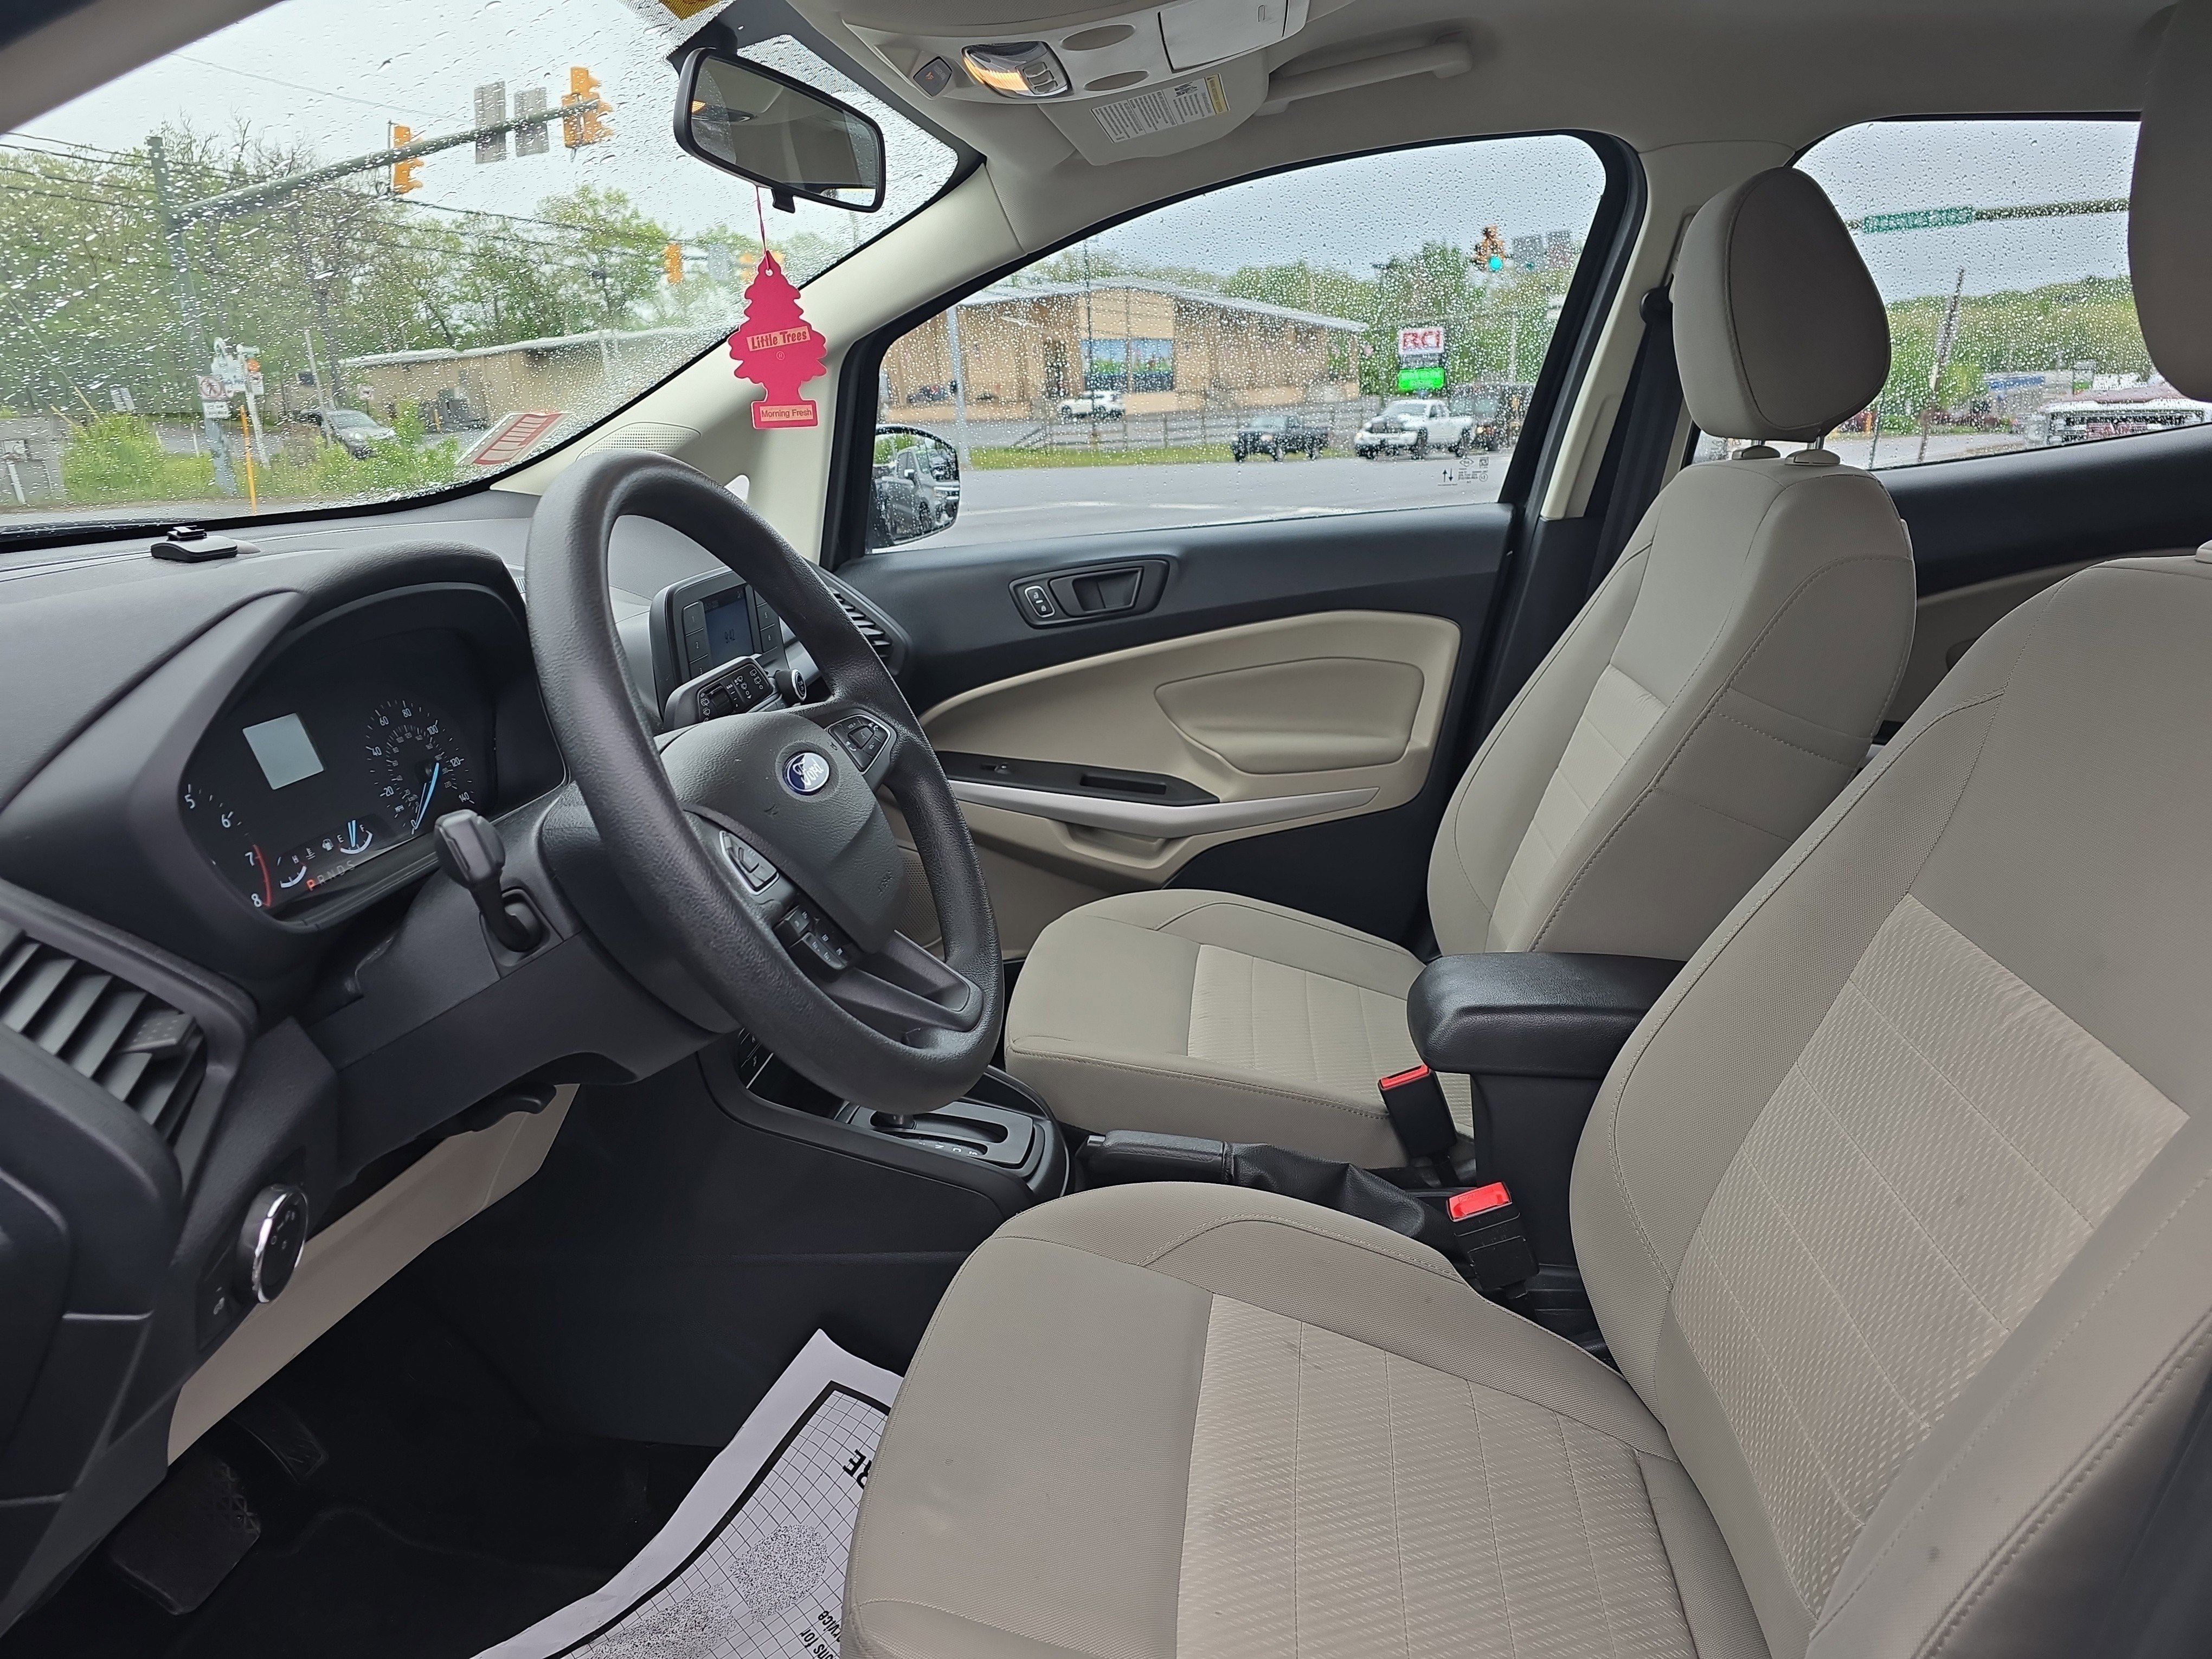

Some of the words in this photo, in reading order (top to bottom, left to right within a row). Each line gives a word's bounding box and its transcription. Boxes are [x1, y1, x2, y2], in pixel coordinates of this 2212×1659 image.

[751, 334, 778, 350] Little
[780, 331, 807, 344] Trees
[761, 410, 790, 419] Morning
[402, 708, 412, 718] 80
[380, 716, 389, 726] 60
[427, 724, 439, 735] 100
[372, 747, 382, 756] 40
[450, 757, 461, 767] 120
[792, 759, 825, 786] Ford
[383, 786, 394, 796] 20
[184, 794, 196, 809] 5
[459, 792, 470, 803] 140
[221, 814, 231, 828] 6
[410, 819, 416, 828] 0
[359, 824, 365, 832] F
[337, 834, 344, 843] E
[245, 852, 254, 866] 7
[292, 855, 300, 864] H
[306, 879, 315, 891] P
[317, 874, 326, 885] R
[327, 870, 336, 879] N
[337, 865, 346, 876] D
[346, 860, 355, 871] S
[251, 893, 263, 908] 8
[818, 1610, 841, 1643] rvice
[799, 1629, 819, 1648] for
